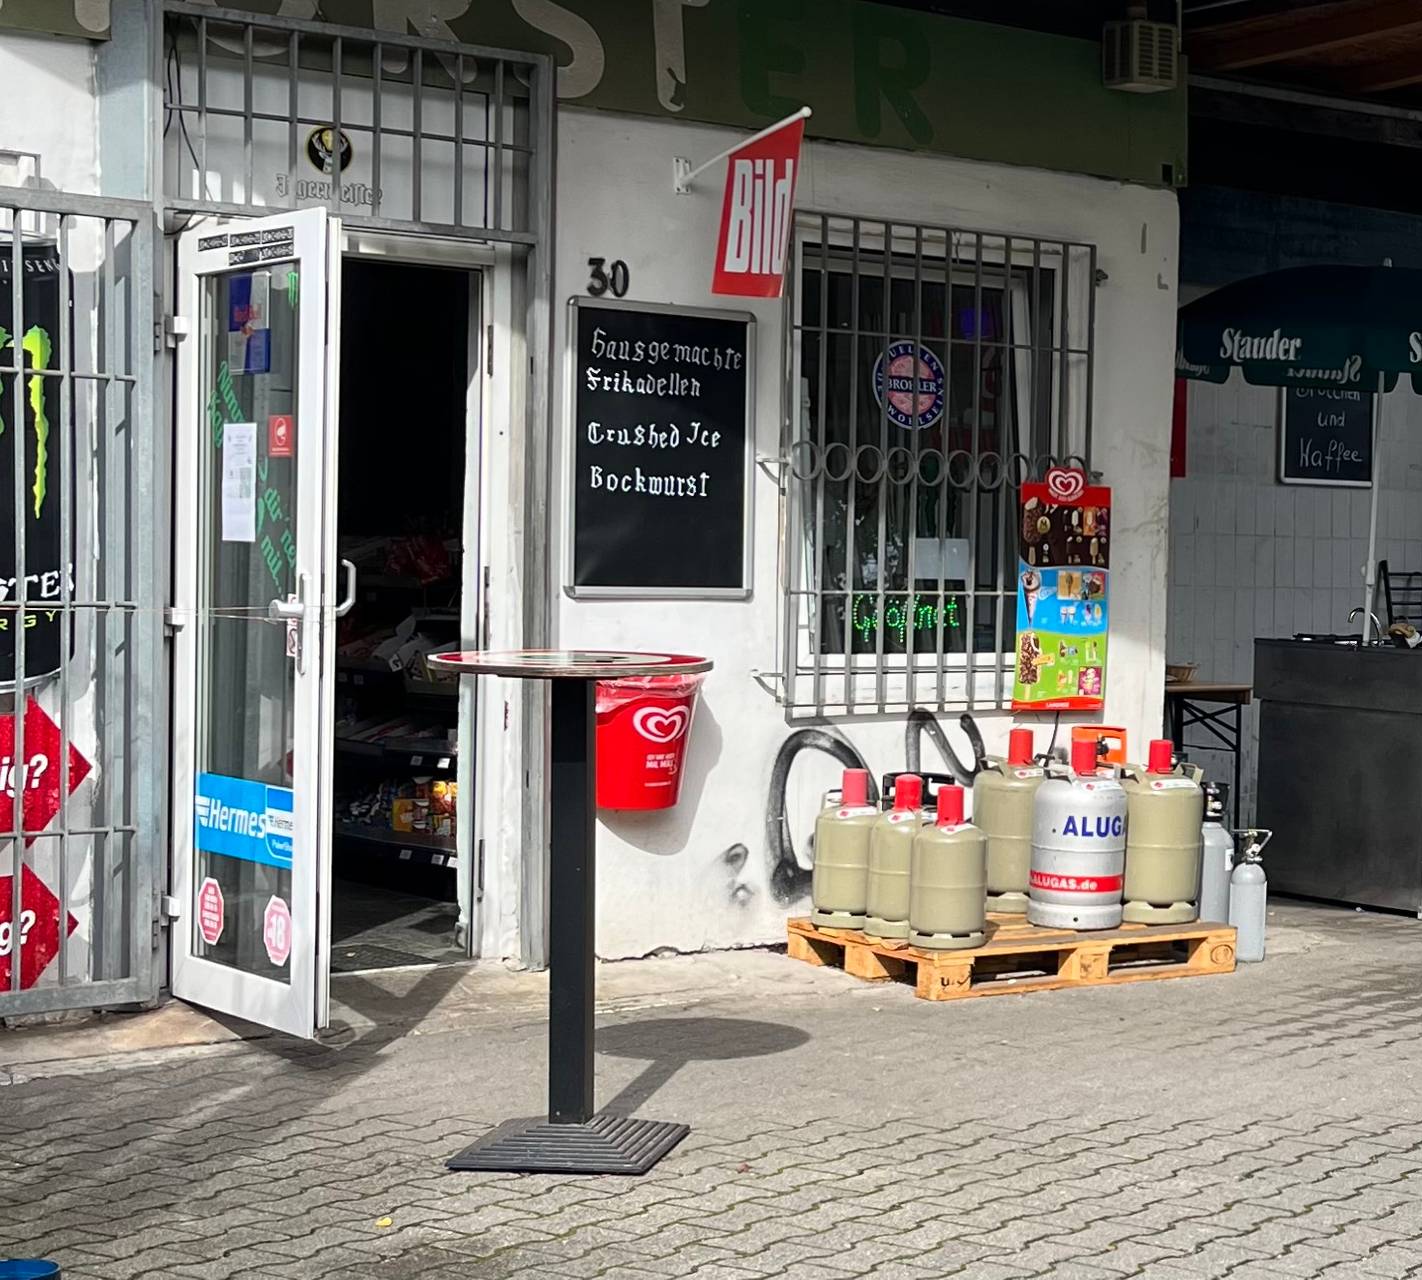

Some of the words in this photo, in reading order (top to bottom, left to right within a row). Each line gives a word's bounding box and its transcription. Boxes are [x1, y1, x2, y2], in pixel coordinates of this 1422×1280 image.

[724, 159, 794, 275] Bild
[587, 257, 629, 298] 30
[592, 328, 742, 371] Hausgemachte
[1220, 328, 1302, 362] Stauder
[586, 367, 701, 397] Frikadellen
[588, 422, 680, 449] Crushed
[686, 421, 721, 449] Ice
[1317, 410, 1345, 428] und
[1300, 437, 1364, 474] Kaffee
[590, 465, 711, 498] Bockwurst
[209, 797, 266, 839] Hermes
